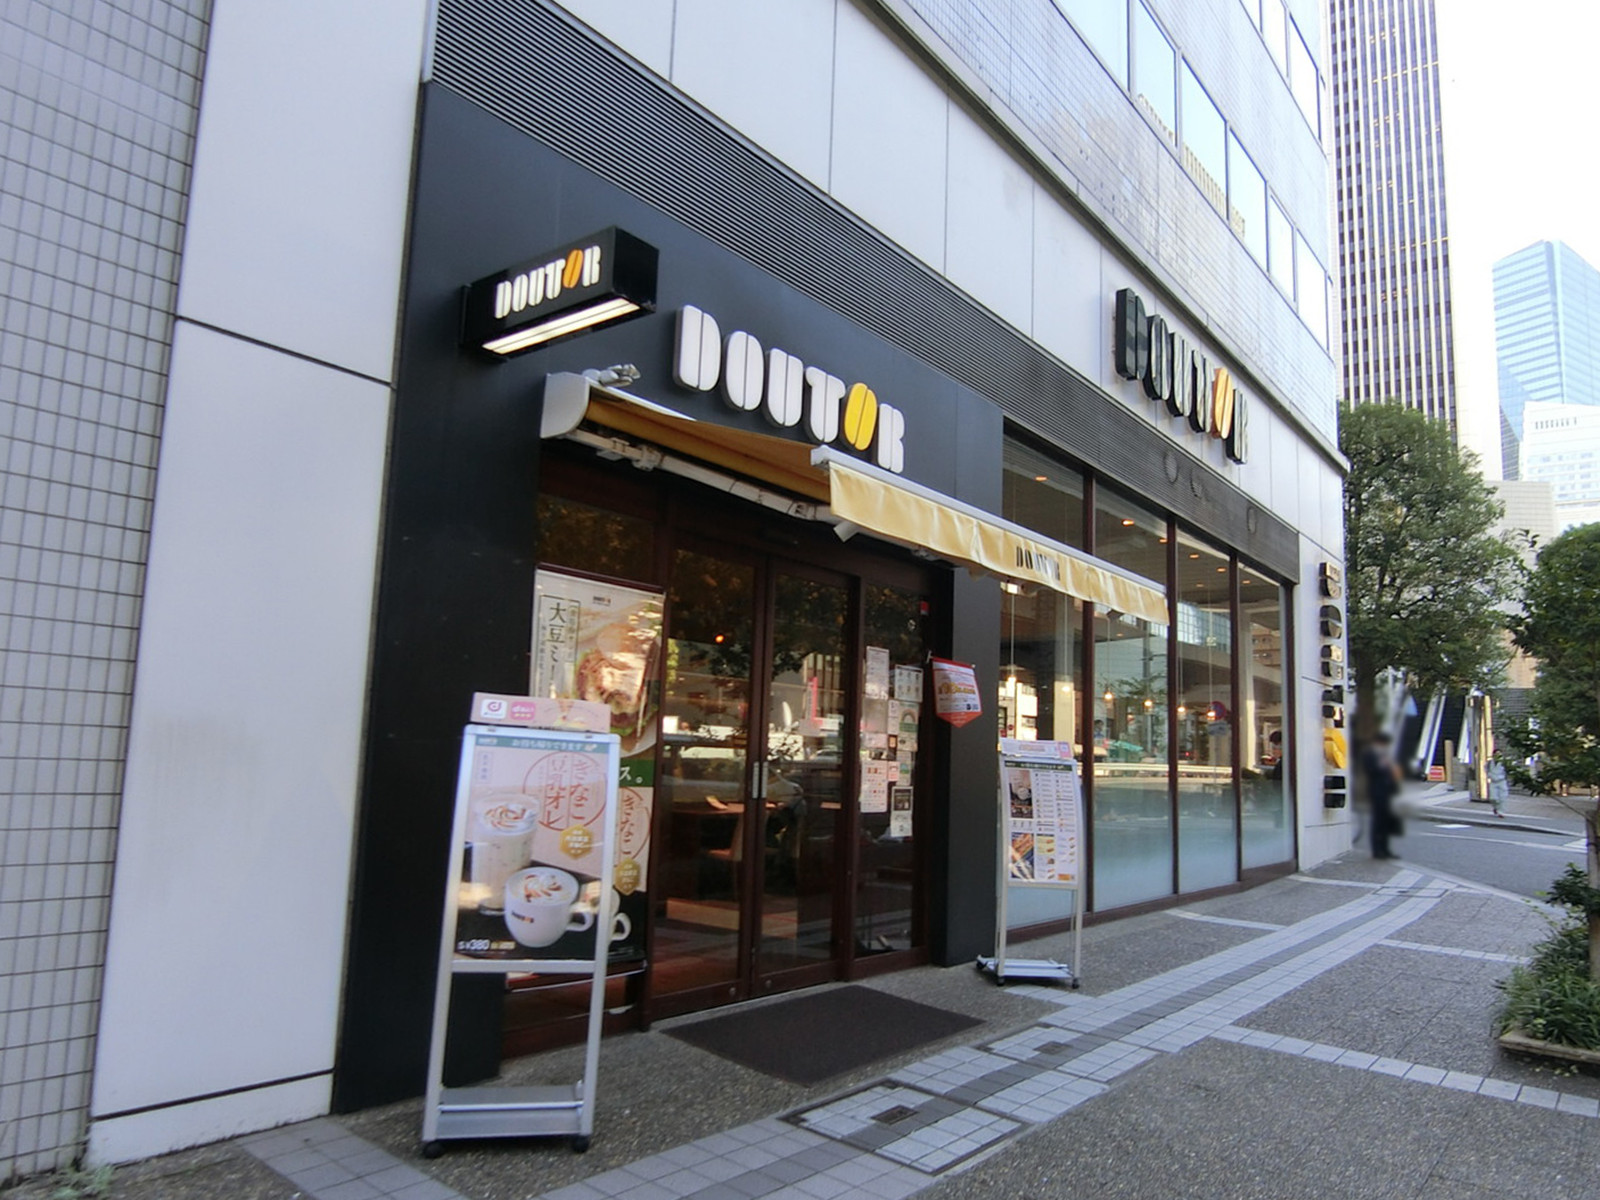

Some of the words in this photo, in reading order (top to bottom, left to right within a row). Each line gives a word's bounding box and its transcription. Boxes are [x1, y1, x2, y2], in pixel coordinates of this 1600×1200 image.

[494, 245, 601, 319] DOUTOR
[675, 304, 906, 474] DOUTOR
[1116, 288, 1248, 464] DOUTOR
